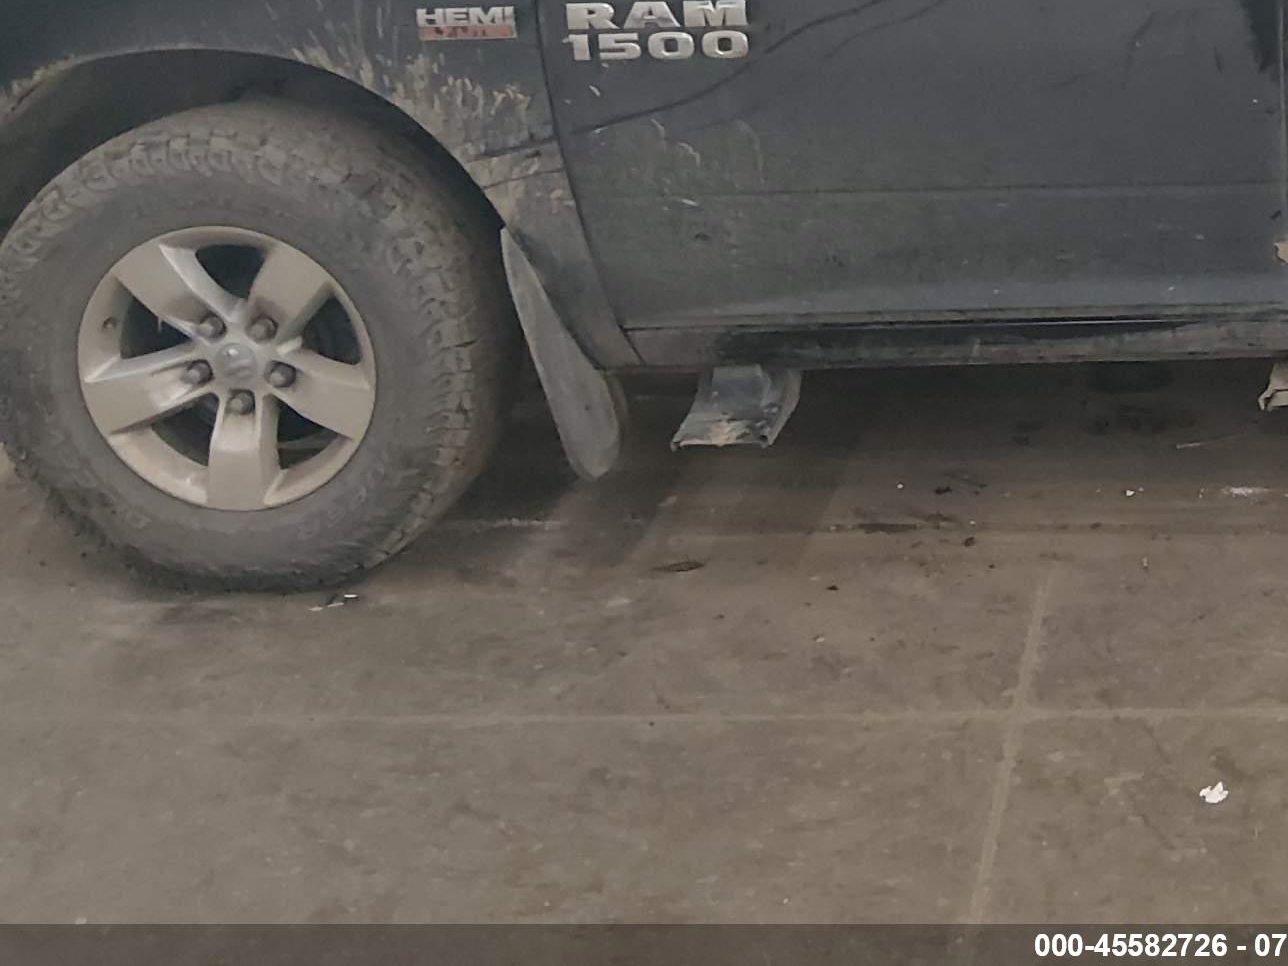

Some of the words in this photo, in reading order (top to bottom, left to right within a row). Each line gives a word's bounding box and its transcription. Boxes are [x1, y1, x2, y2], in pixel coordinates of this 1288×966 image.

[416, 6, 514, 27] HEMI
[566, 0, 749, 30] RAM
[562, 30, 749, 61] 1500
